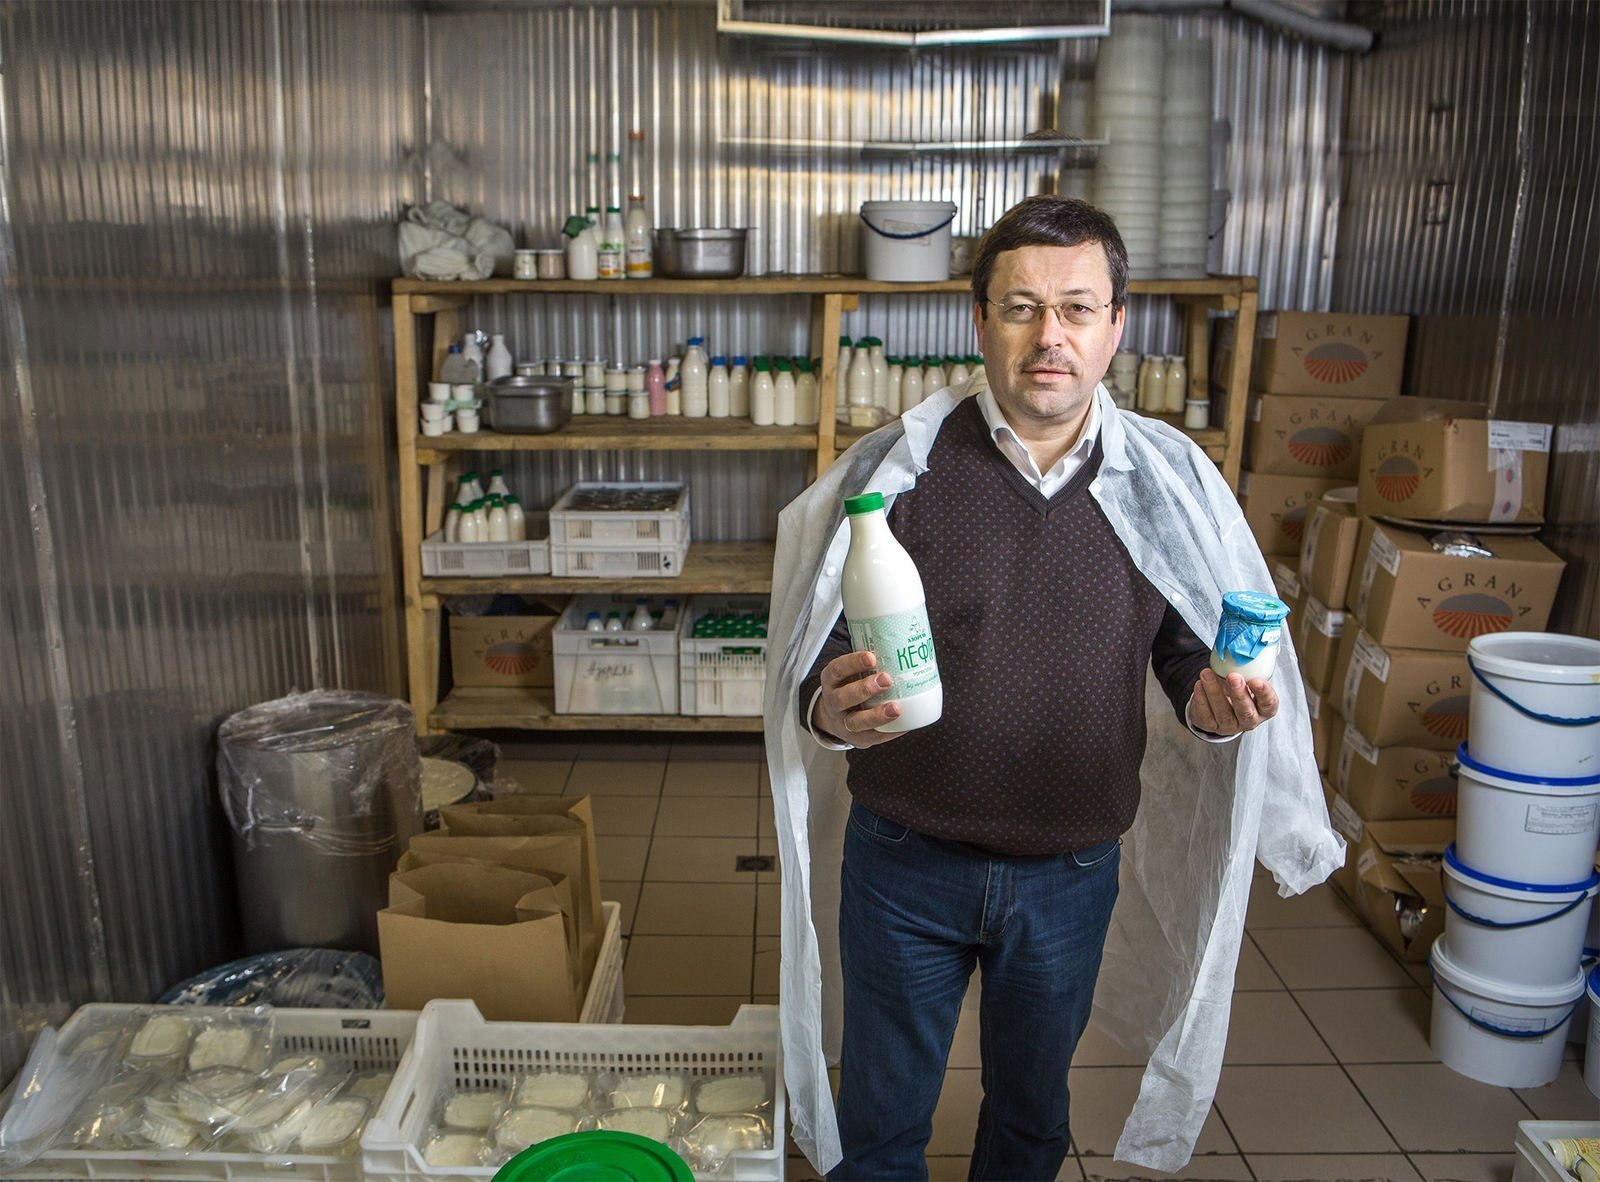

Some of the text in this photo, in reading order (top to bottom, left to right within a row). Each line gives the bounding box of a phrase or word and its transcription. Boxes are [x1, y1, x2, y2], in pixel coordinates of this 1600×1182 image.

[1417, 572, 1532, 617] AGRANA
[1408, 675, 1462, 713] AGR
[1395, 756, 1450, 790] AGR
